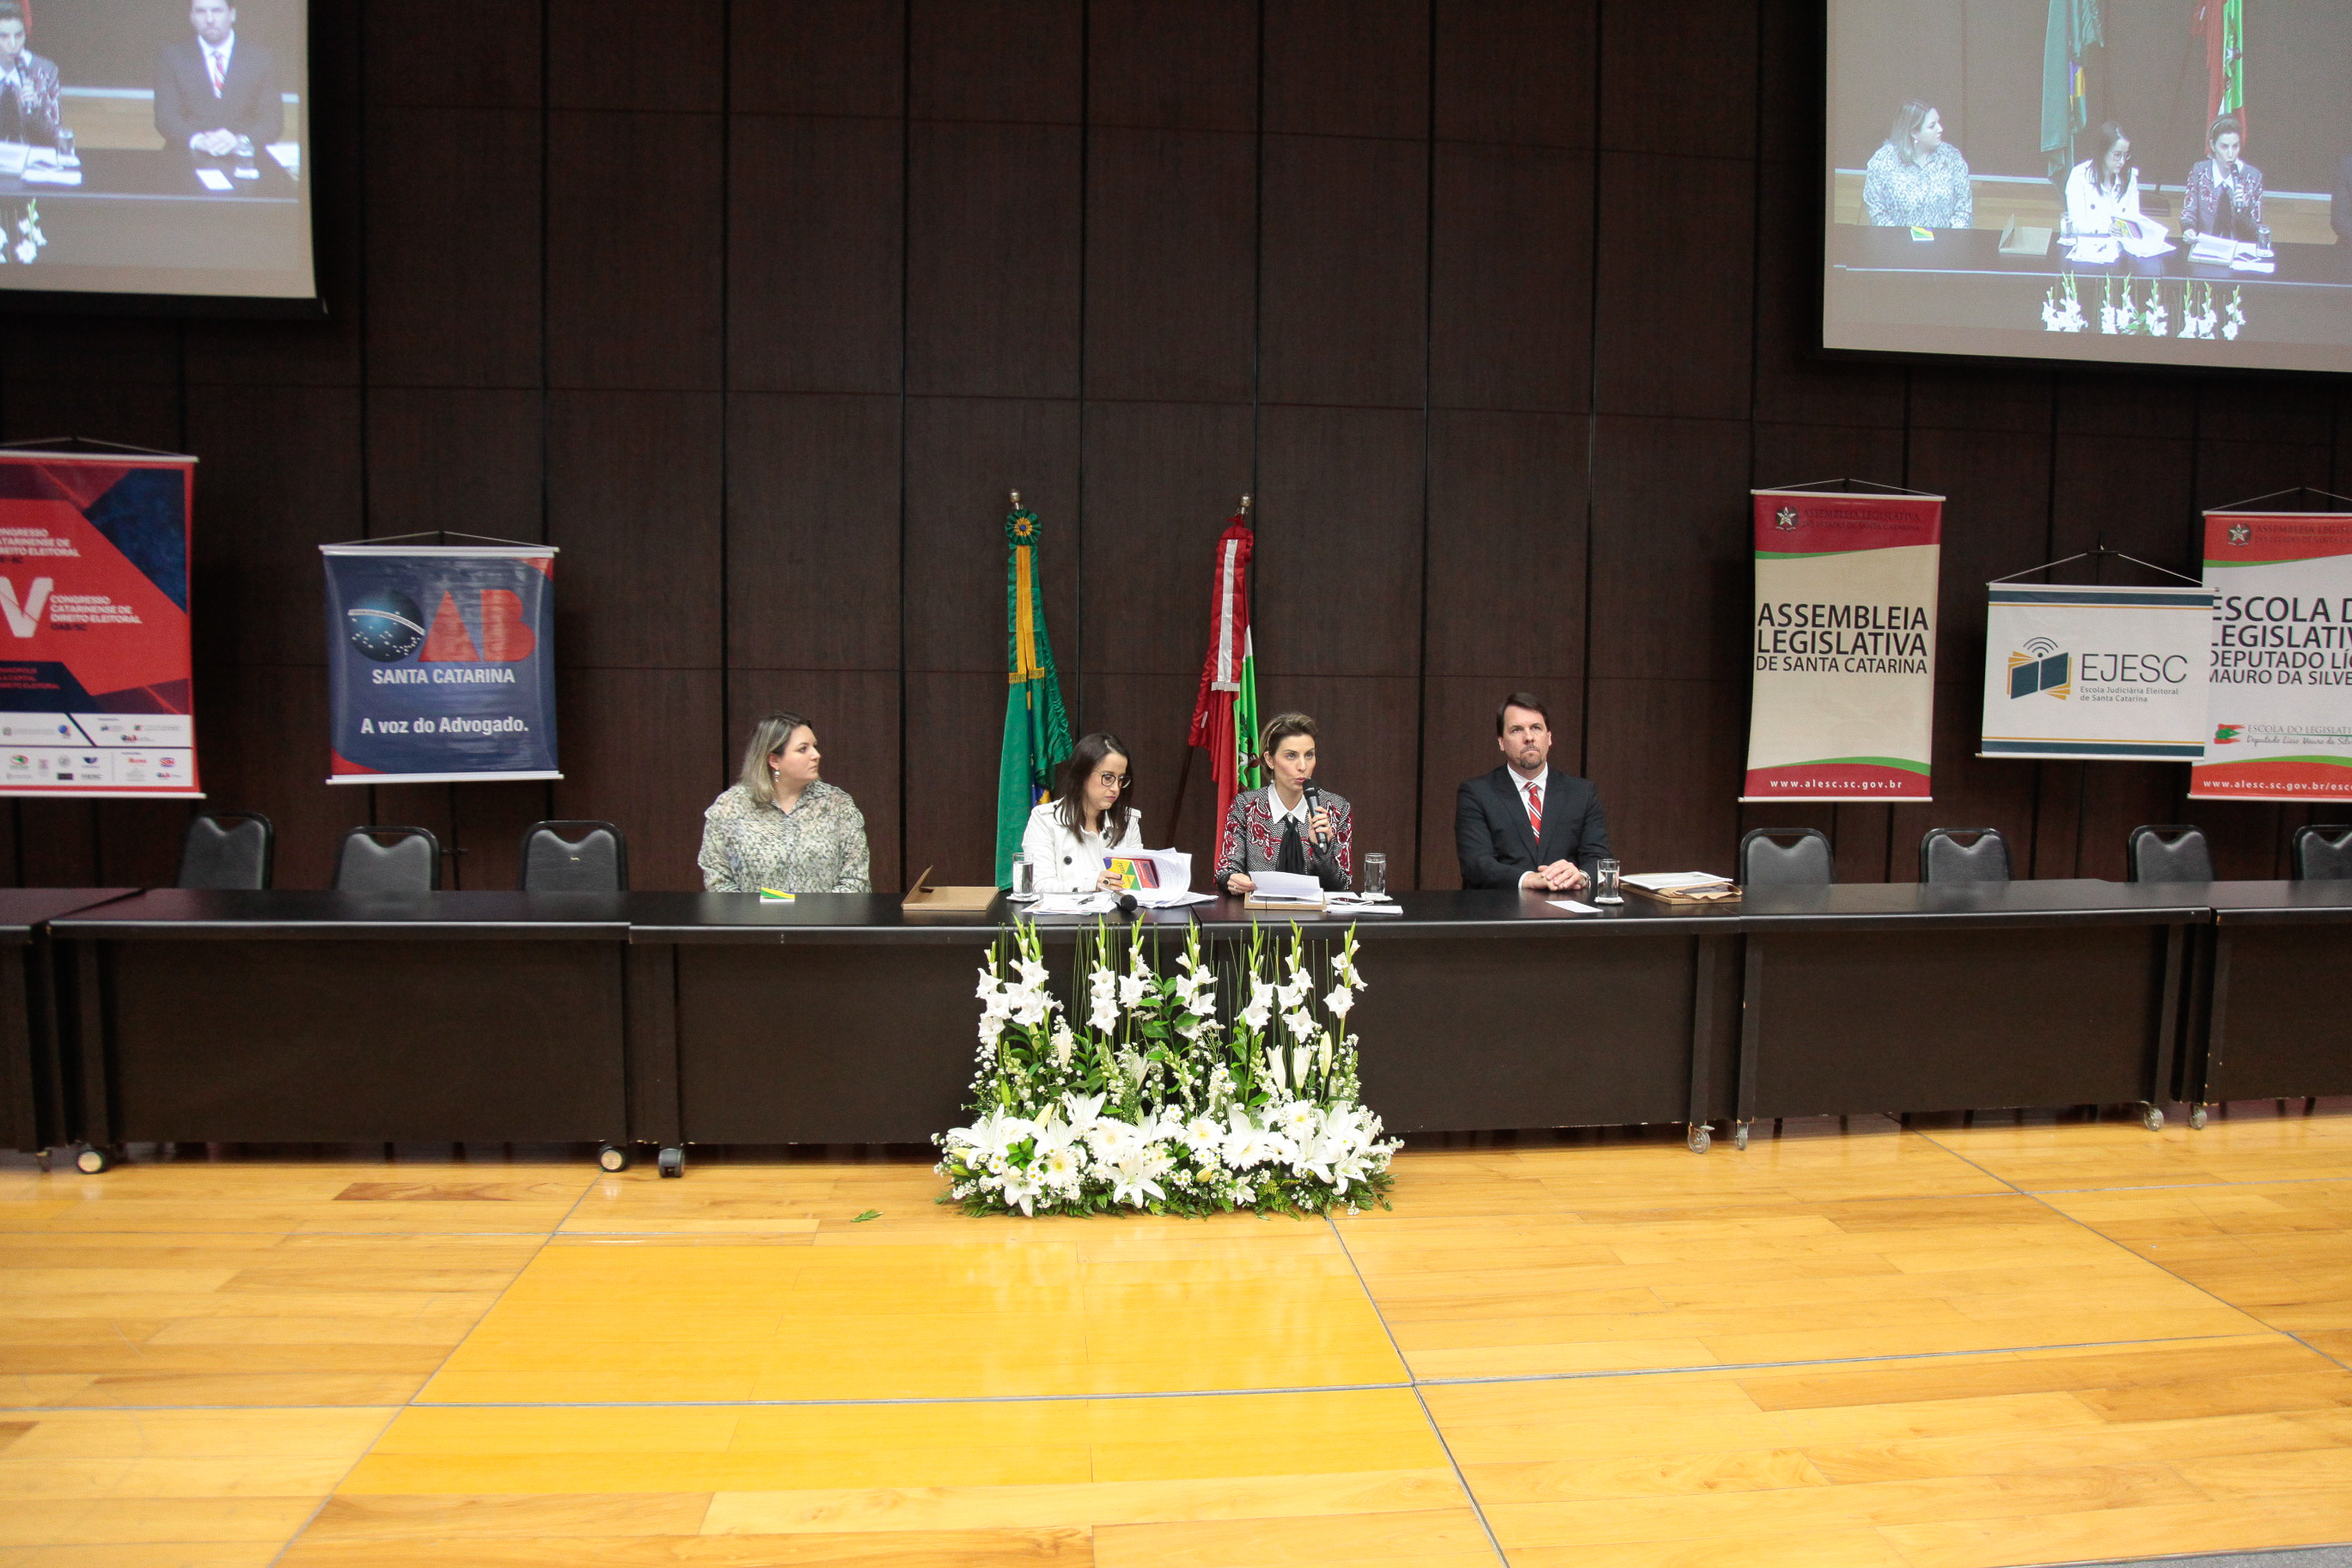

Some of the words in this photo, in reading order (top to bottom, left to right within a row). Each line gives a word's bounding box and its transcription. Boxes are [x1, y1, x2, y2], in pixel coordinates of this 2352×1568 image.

[1757, 603, 1929, 631] ASSEMBLEIA
[1757, 629, 1927, 656] LEGISLATIVA
[1756, 656, 1778, 671] DE
[1782, 656, 1840, 672] SANTA
[1844, 658, 1927, 674] CATARINA
[2081, 653, 2188, 684] EJESC
[372, 668, 429, 684] SANTA
[432, 668, 516, 684] CATARINA
[2277, 670, 2302, 685] DA
[360, 717, 375, 734] A
[378, 721, 409, 733] voz
[413, 717, 435, 733] do
[439, 716, 530, 735] Advogado.
[2246, 735, 2280, 747] Deputado
[1769, 779, 1903, 790] www.alesc.sc.gov.br
